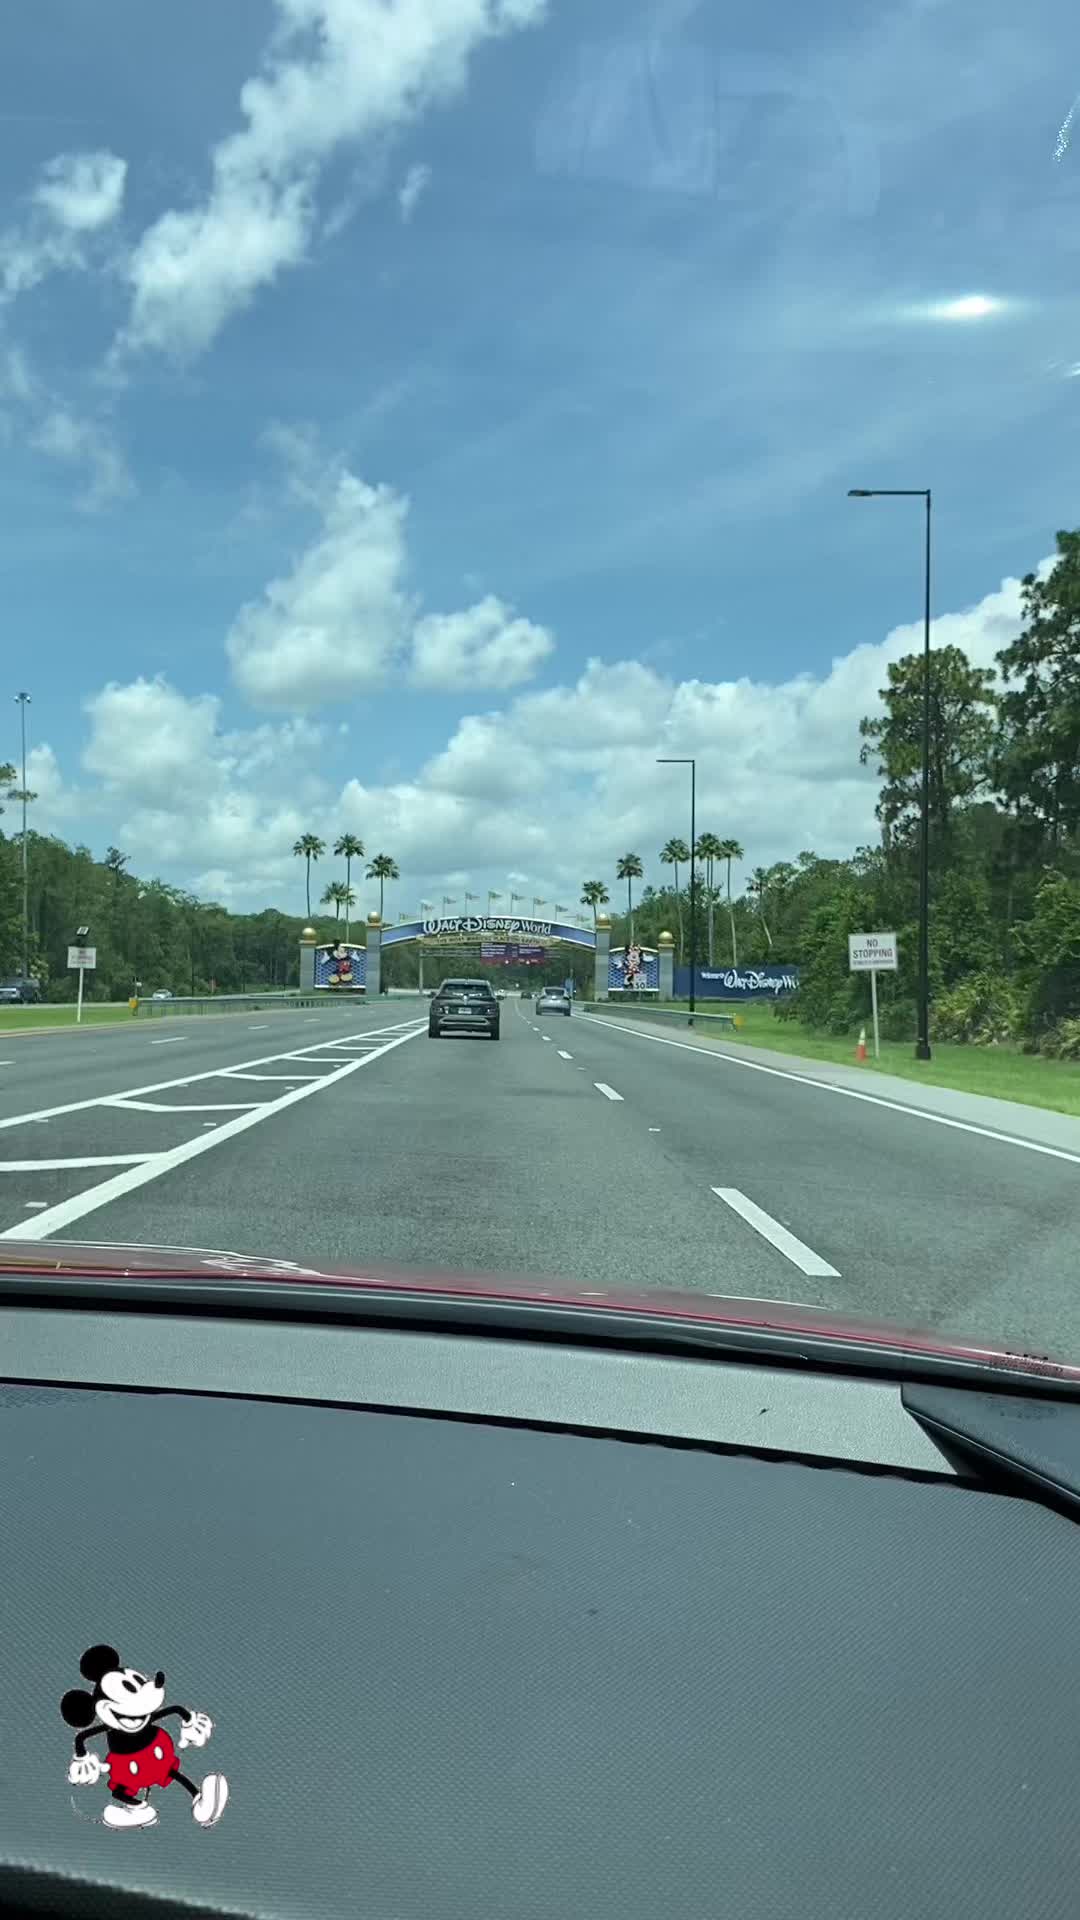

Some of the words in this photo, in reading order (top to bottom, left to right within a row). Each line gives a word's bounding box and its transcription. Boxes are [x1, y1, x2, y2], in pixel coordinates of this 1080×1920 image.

[521, 920, 552, 935] World
[866, 939, 879, 948] NO
[852, 948, 893, 959] STOPPING
